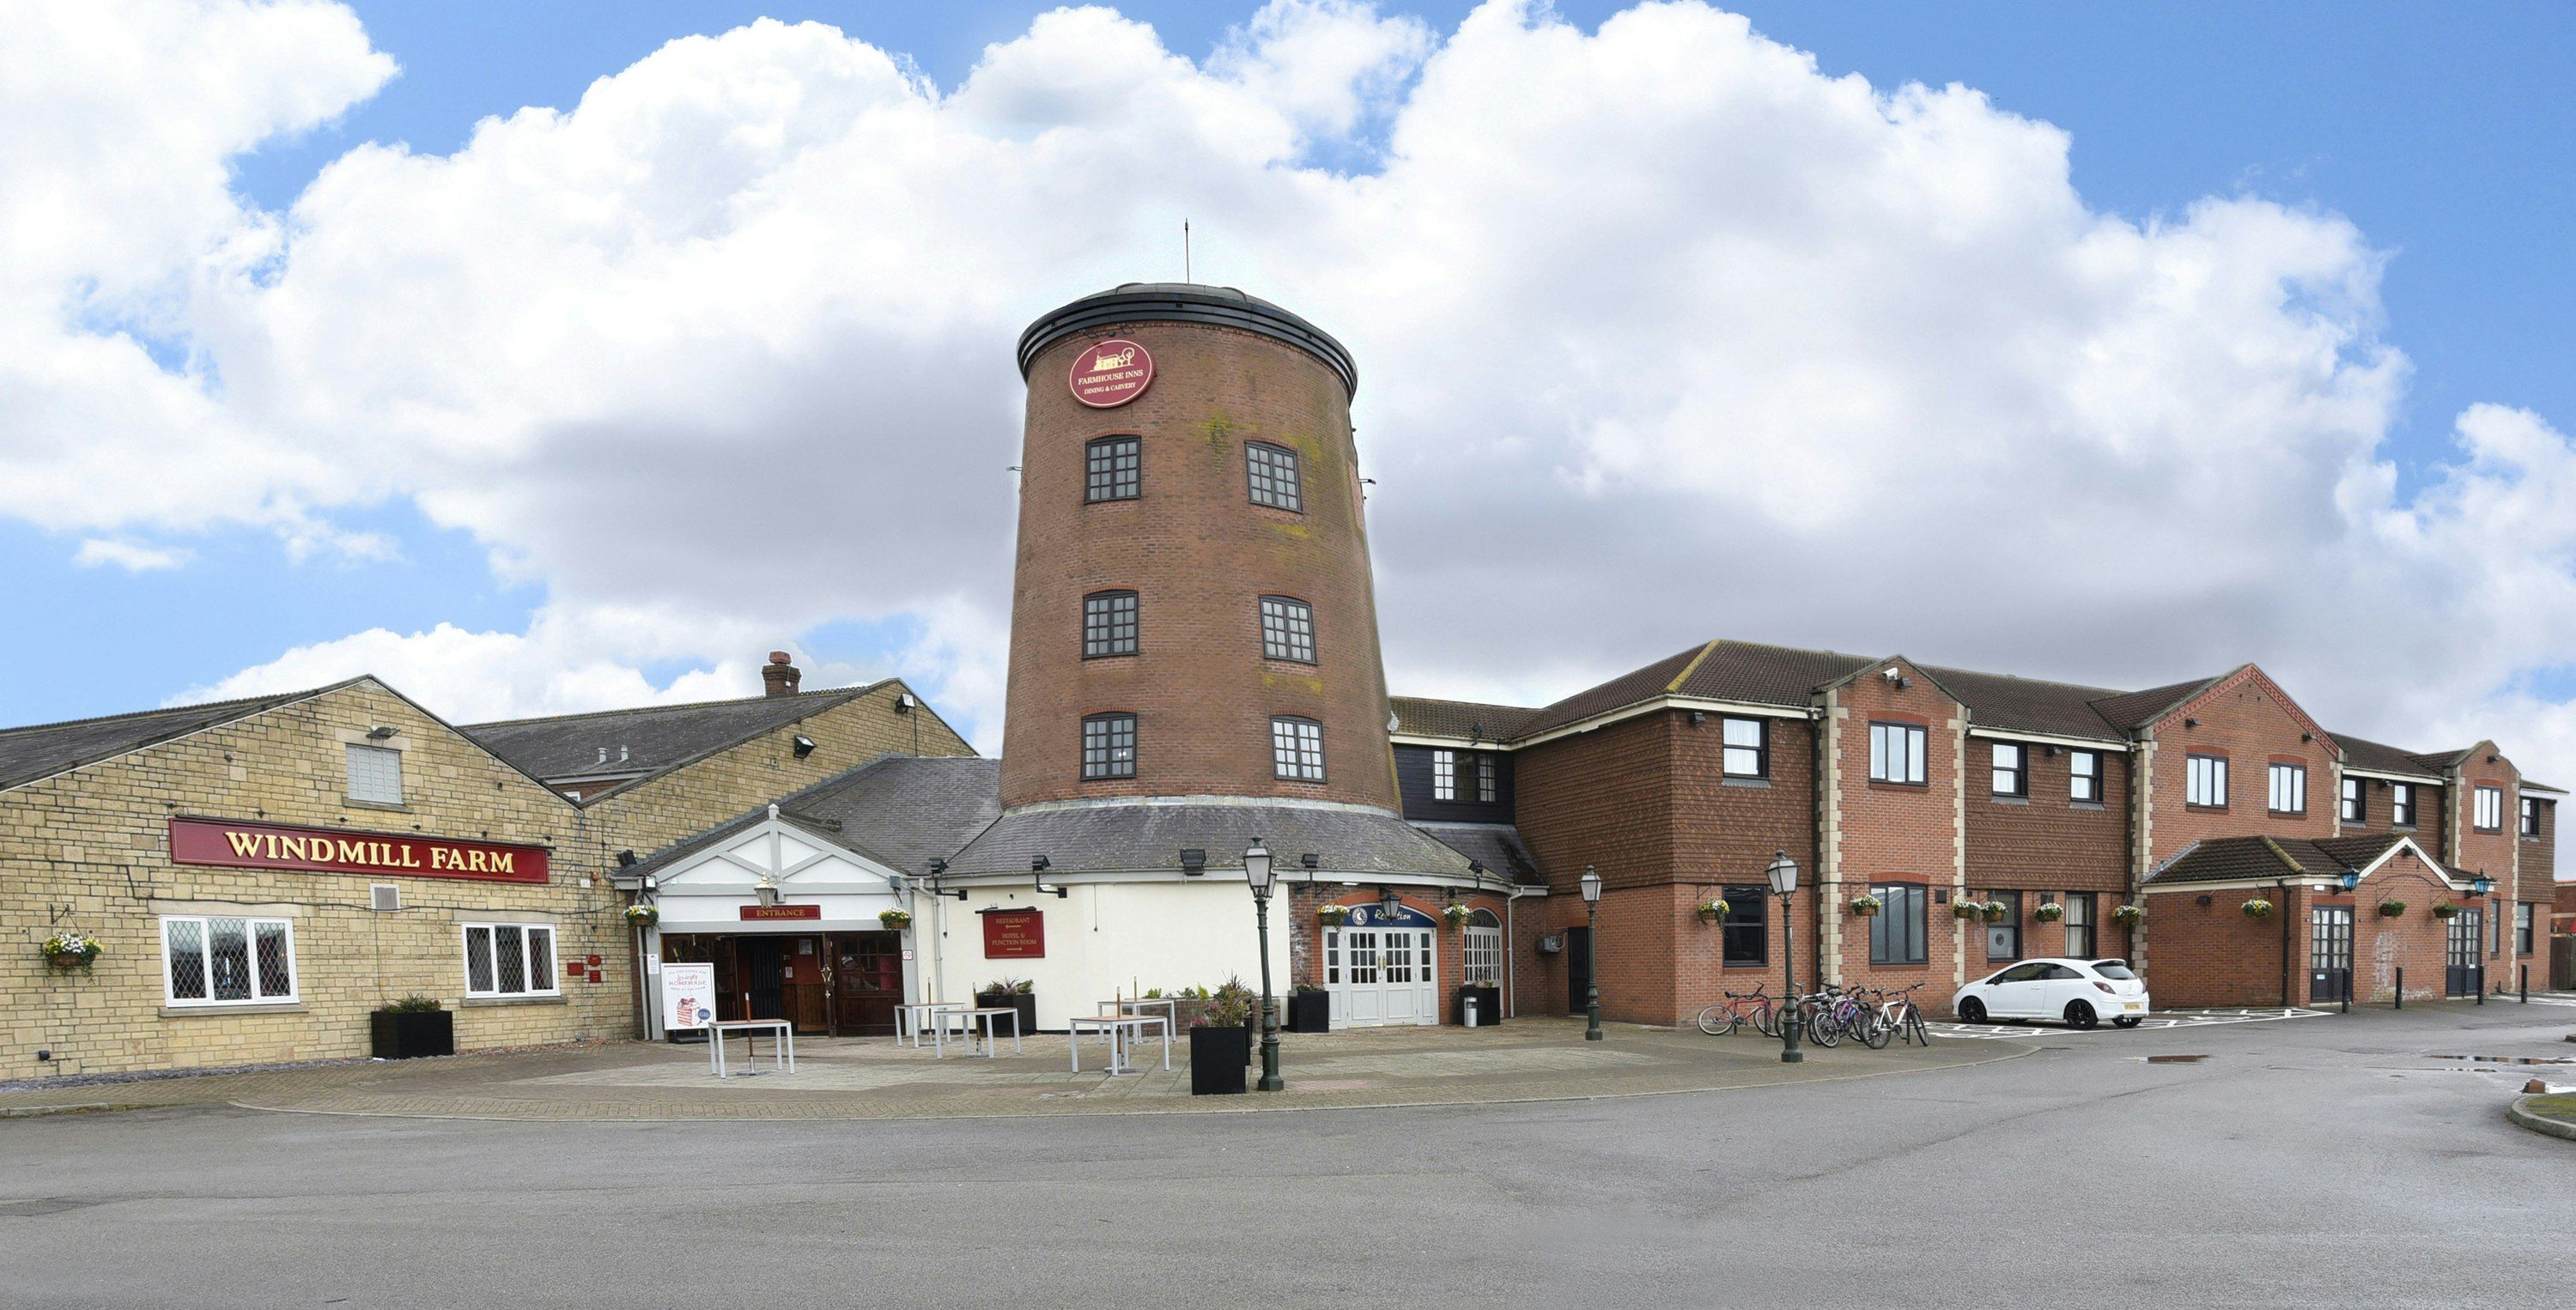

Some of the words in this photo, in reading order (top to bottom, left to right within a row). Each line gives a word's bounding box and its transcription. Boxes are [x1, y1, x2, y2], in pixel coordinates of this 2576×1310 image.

[1078, 373, 1124, 385] FARMHOUSE
[1125, 369, 1144, 379] INNS
[1110, 383, 1136, 391] CARVERY
[225, 832, 420, 868] WINDMILL
[430, 846, 514, 874] FARM
[1374, 909, 1412, 920] Retion
